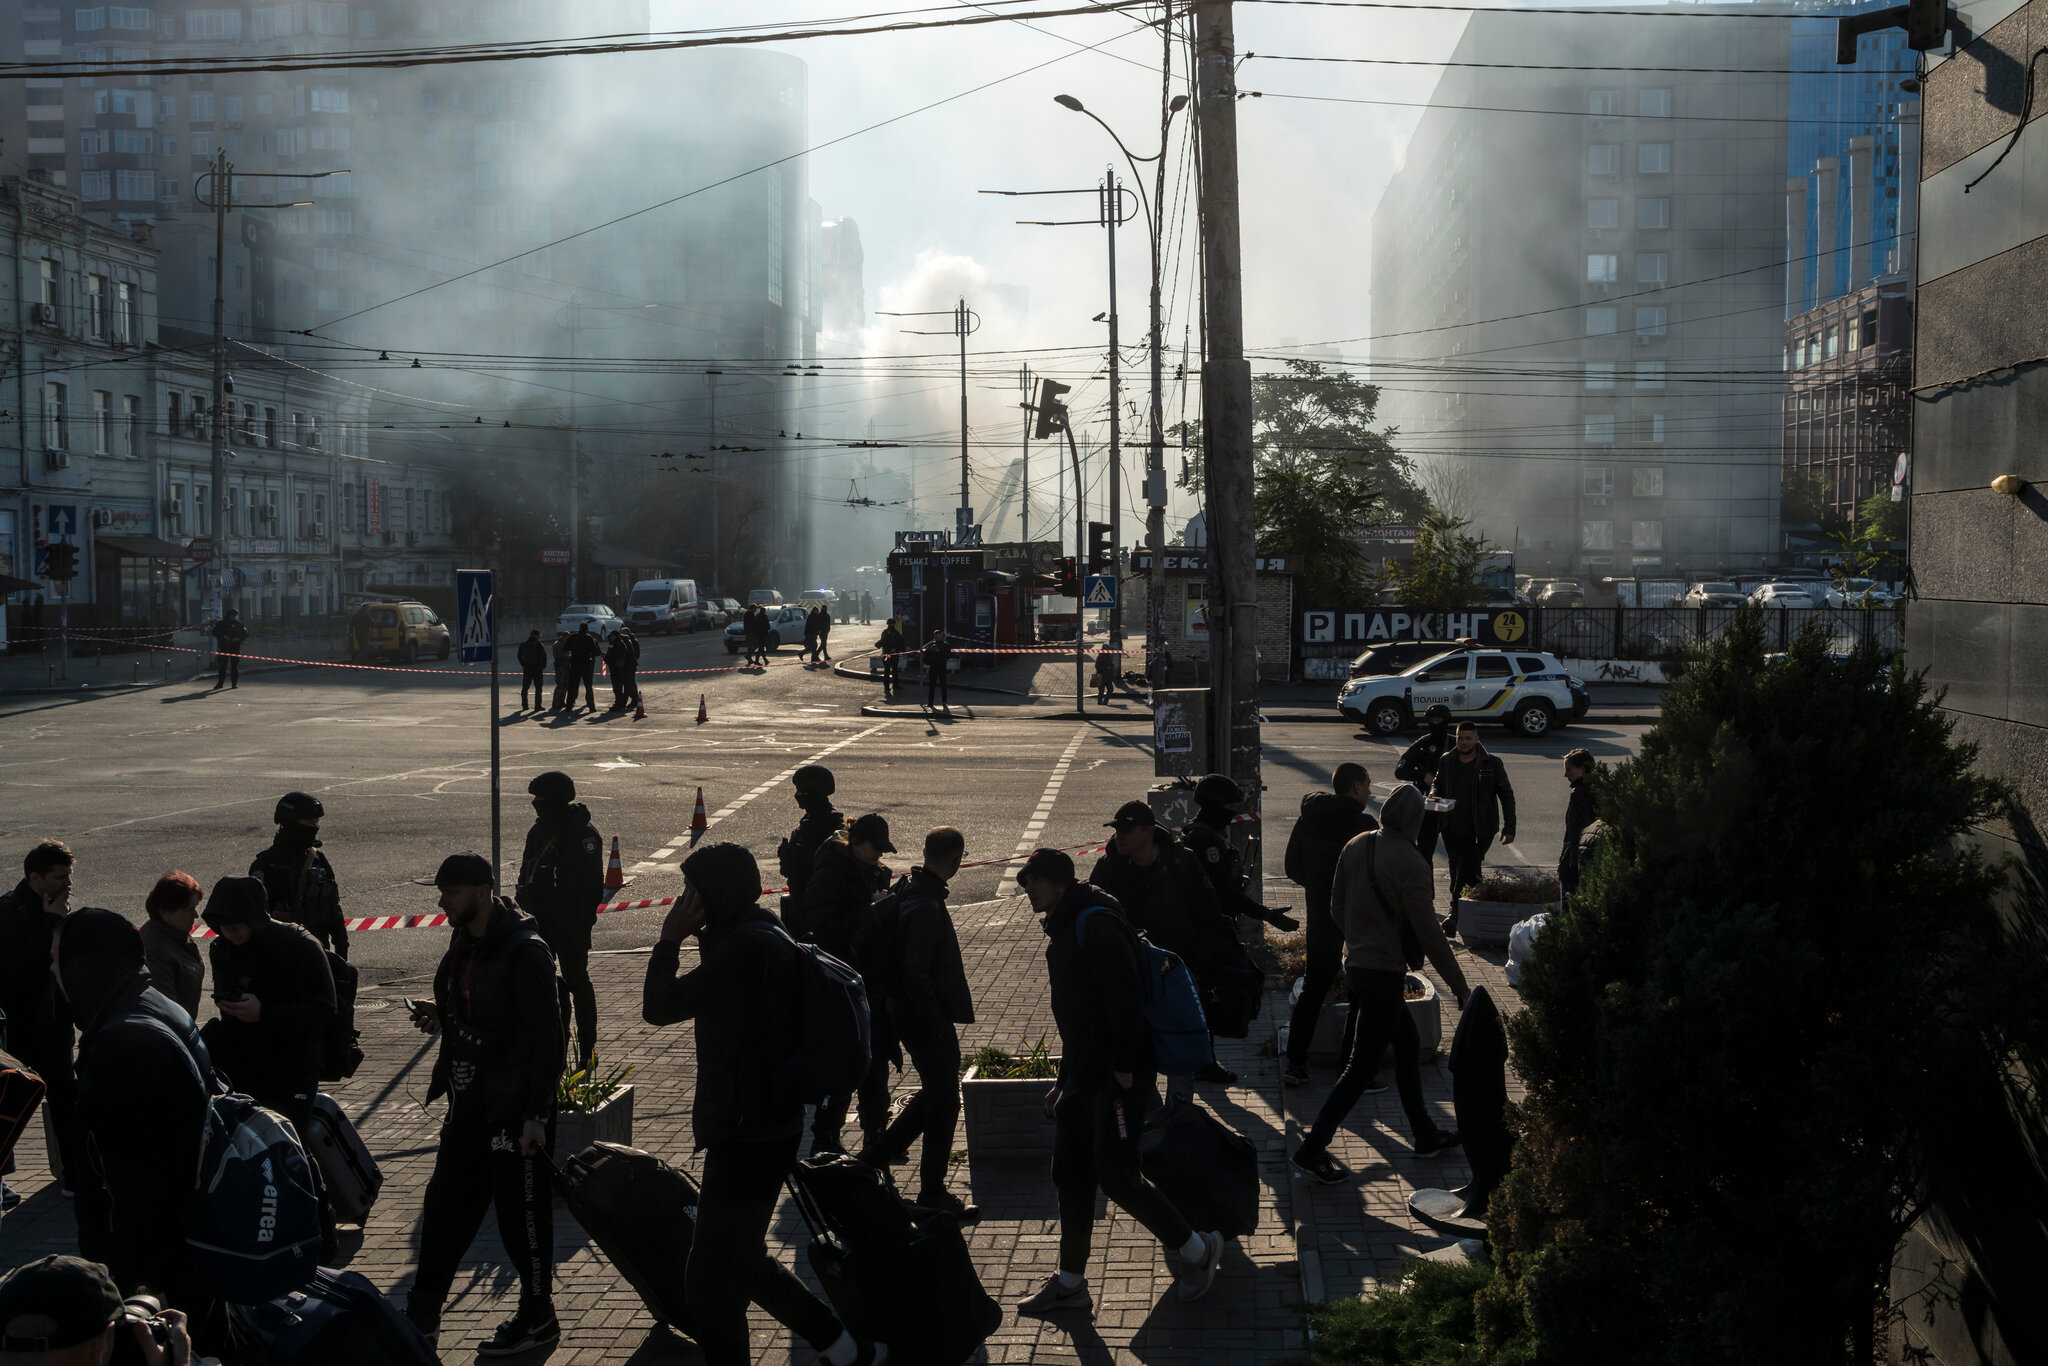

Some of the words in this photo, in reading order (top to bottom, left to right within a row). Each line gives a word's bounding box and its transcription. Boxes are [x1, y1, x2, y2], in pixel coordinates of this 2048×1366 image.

[953, 524, 983, 548] 24
[1139, 556, 1285, 571] ПЕКЯ
[1502, 613, 1517, 626] 24
[1505, 628, 1513, 641] 7
[1413, 696, 1450, 704] ПОЛІЦІЯ
